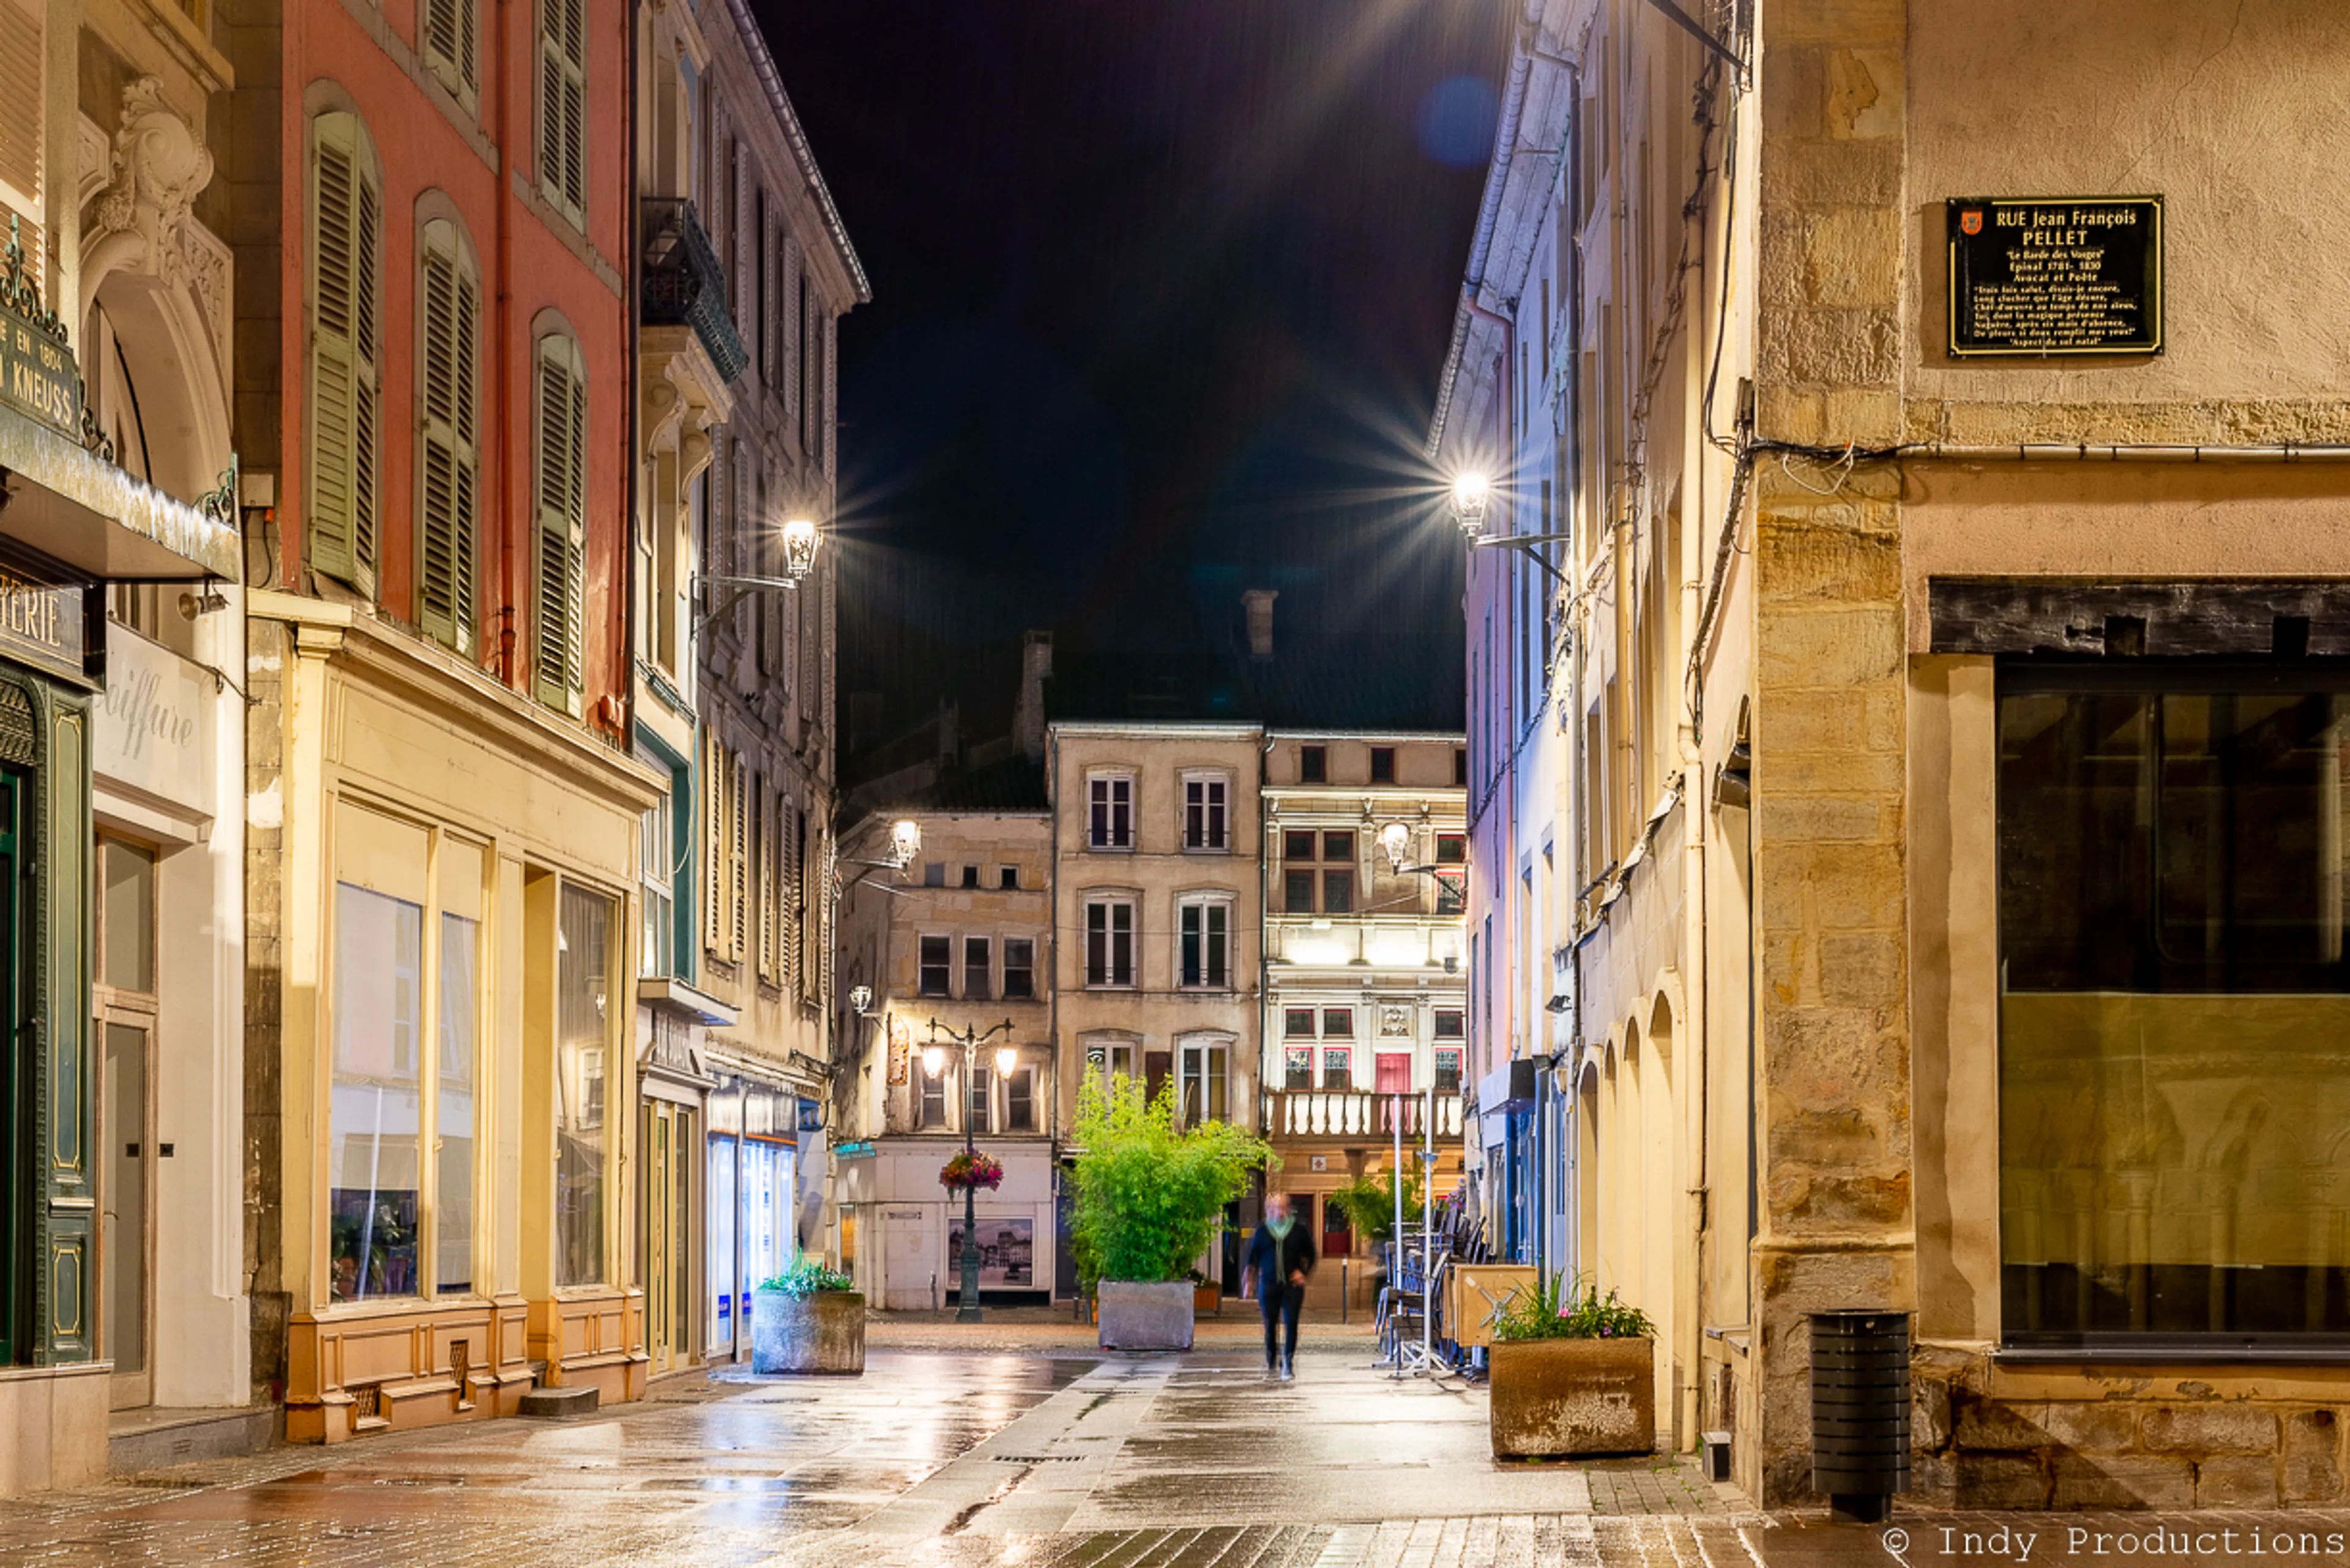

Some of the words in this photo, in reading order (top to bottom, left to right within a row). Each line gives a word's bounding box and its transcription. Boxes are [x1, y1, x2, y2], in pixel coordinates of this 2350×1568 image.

[1996, 211, 2026, 226] RUE
[2033, 211, 2065, 227] Jean
[2073, 209, 2136, 229] François
[2023, 230, 2087, 245] PELLET
[2023, 250, 2050, 259] Barde
[2013, 272, 2049, 282] Avocat
[17, 329, 30, 355] EN
[40, 343, 62, 374] 1804
[13, 360, 72, 425] KNEUSS
[94, 668, 193, 760] oiffure
